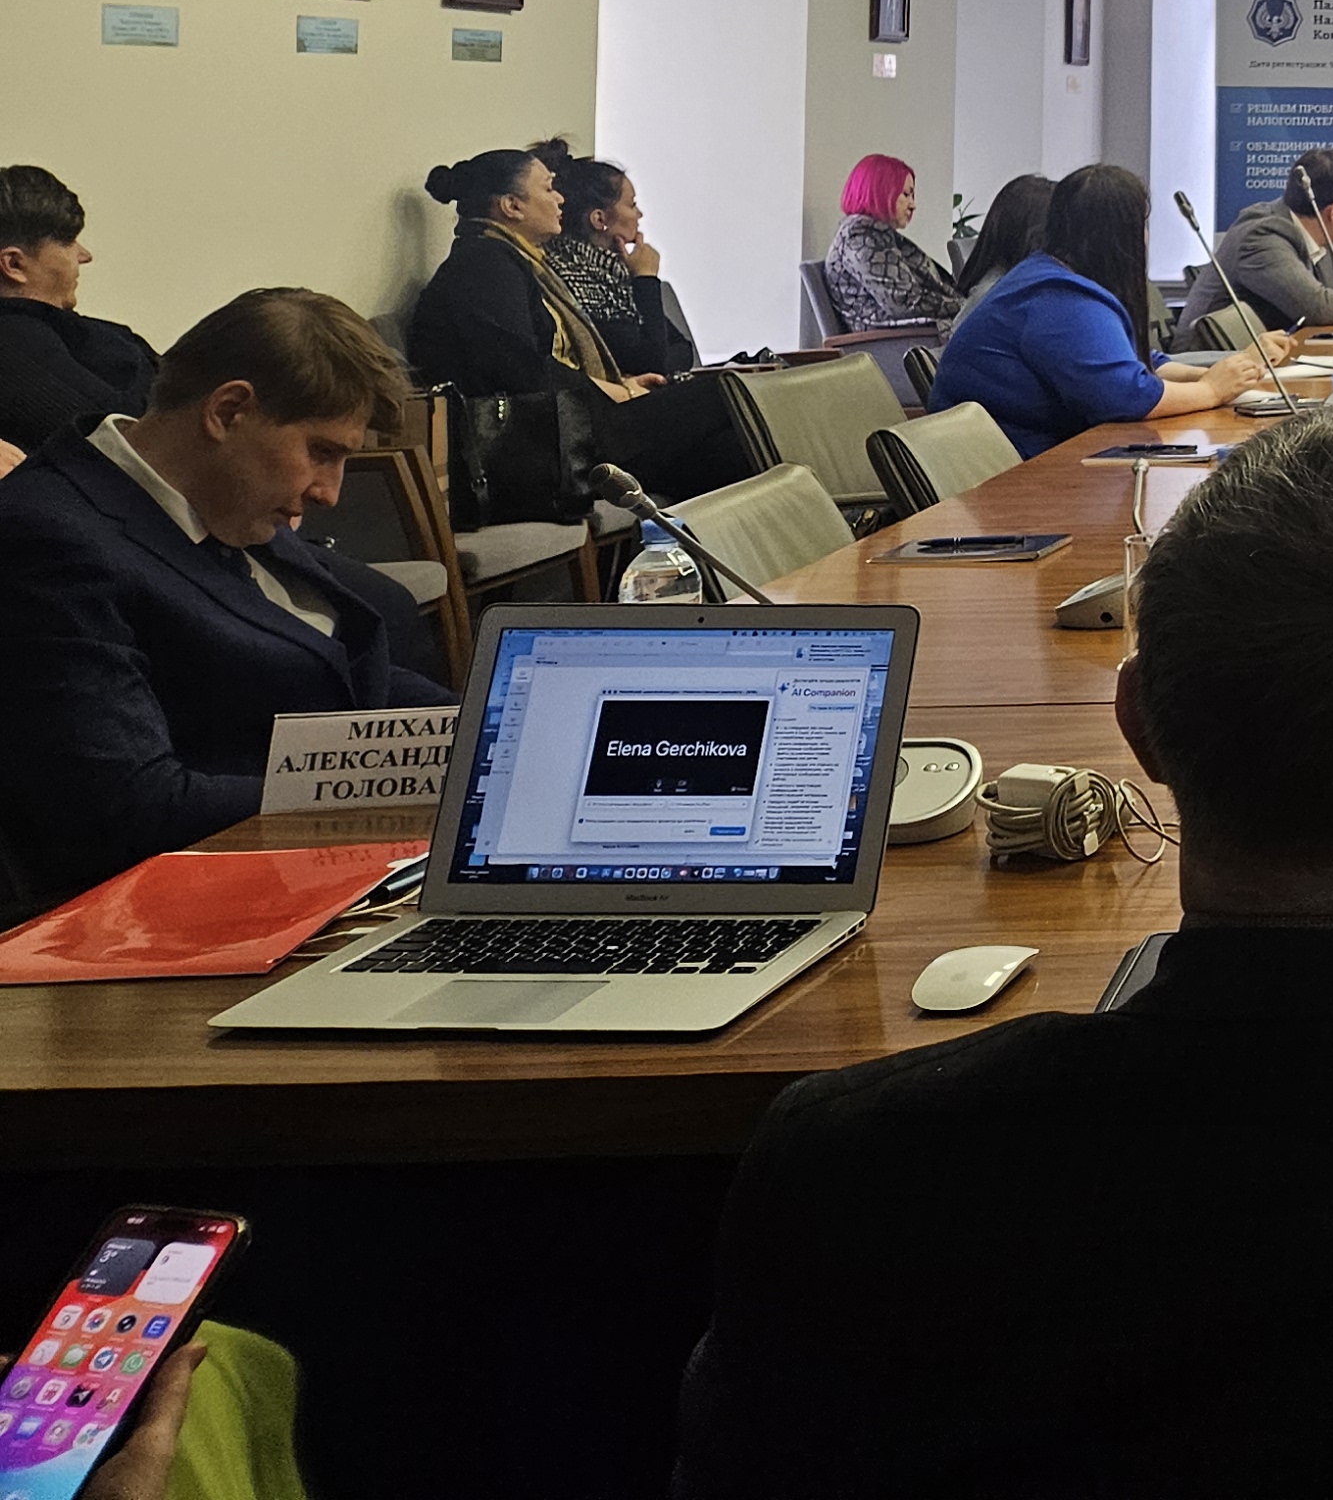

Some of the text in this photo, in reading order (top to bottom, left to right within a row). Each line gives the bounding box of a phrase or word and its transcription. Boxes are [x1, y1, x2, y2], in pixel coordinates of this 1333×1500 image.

[1247, 103, 1297, 114] РЕШАЕМ
[1246, 141, 1326, 152] ОБЪЕДИНЯЕМ
[1246, 154, 1256, 164] И
[1257, 154, 1291, 164] ОПЫТ
[1246, 179, 1287, 189] СООБЩ
[791, 688, 856, 698] AI Companion
[347, 716, 458, 740] МИХАИ
[607, 740, 747, 757] Elena Gerchikova
[275, 745, 451, 773] АЛЕКСАНД
[313, 775, 445, 801] ГОЛОВА
